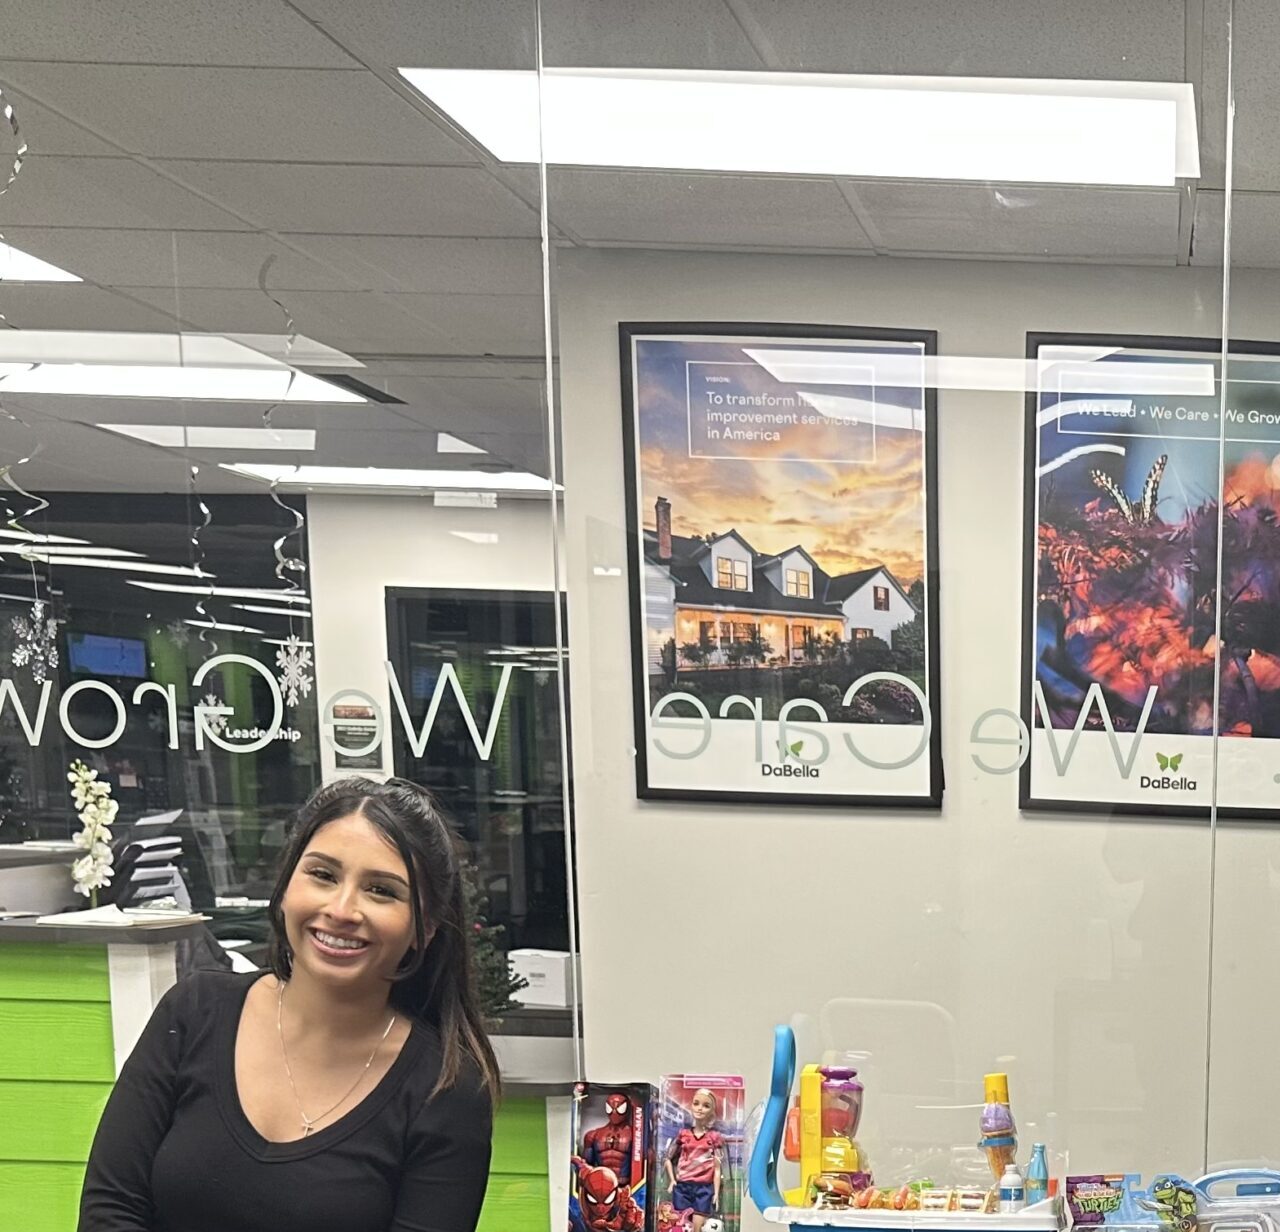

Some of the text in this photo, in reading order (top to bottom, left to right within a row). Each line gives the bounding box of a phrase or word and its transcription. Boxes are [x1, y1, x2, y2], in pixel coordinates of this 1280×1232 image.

[707, 391, 723, 405] To
[726, 393, 795, 407] transform
[706, 410, 858, 427] improvement services
[1149, 406, 1172, 421] We
[1176, 407, 1209, 423] Care
[707, 427, 780, 442] in America
[761, 763, 819, 778] DaBella
[1140, 776, 1197, 791] DaBella
